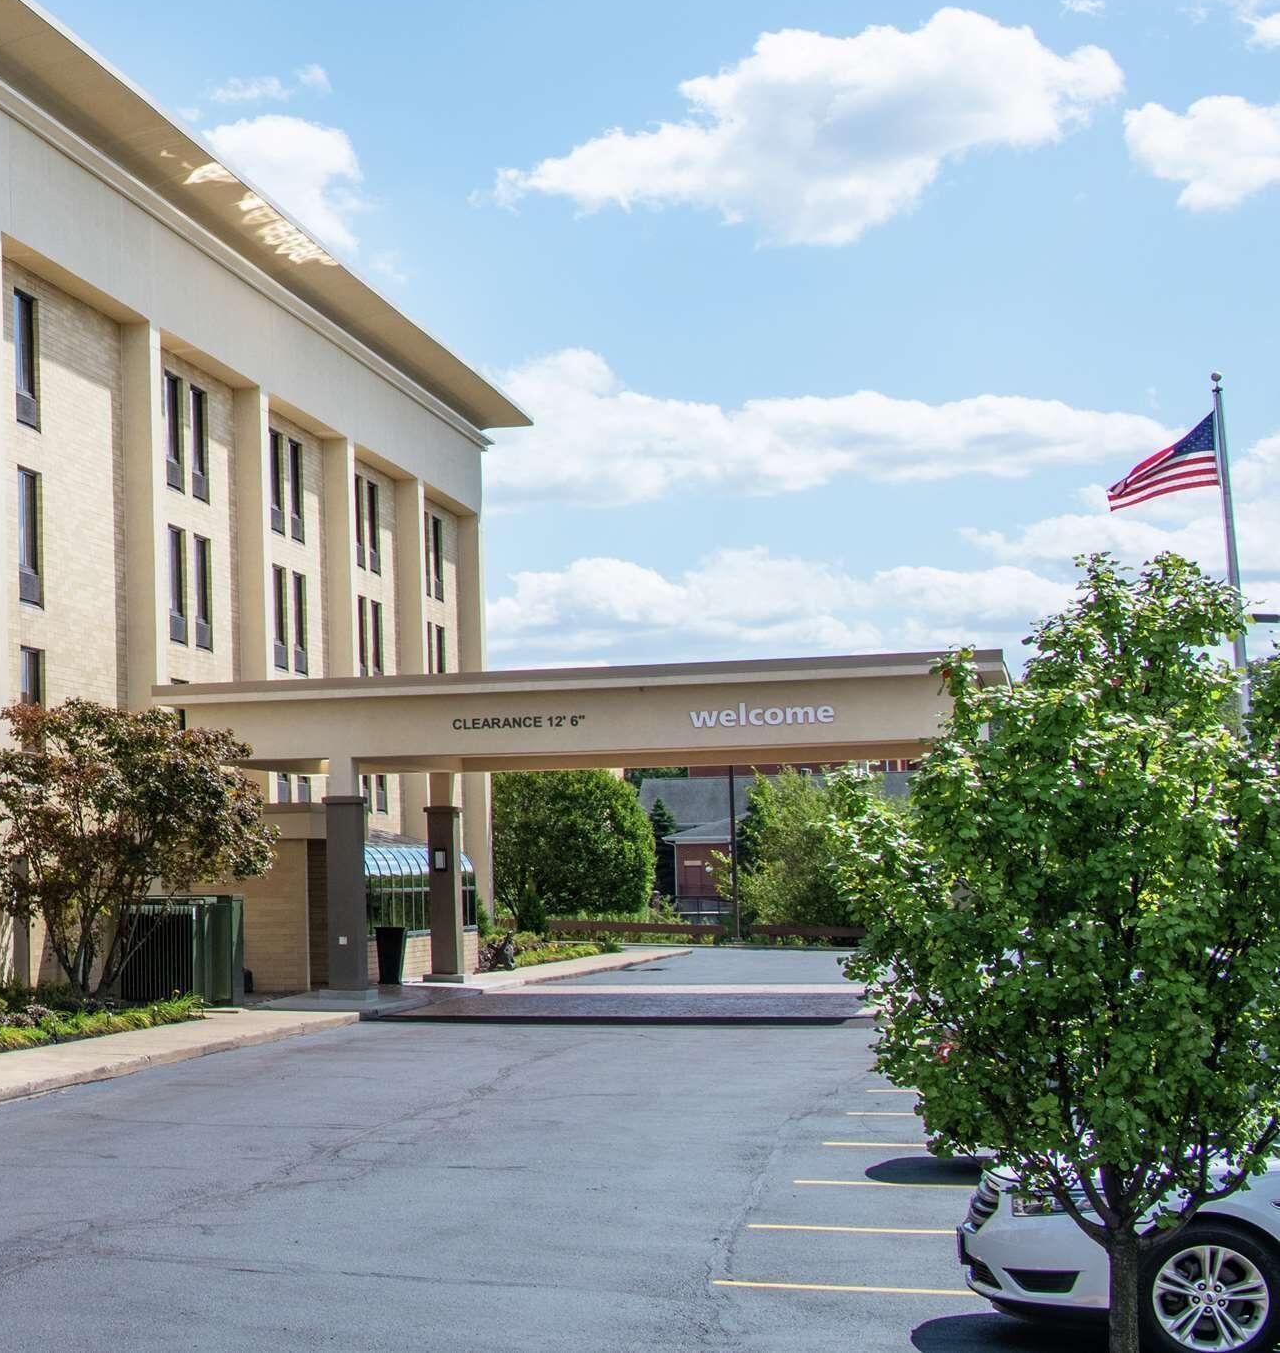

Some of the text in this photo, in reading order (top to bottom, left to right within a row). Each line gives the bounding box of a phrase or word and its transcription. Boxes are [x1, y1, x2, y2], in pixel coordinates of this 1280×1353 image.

[452, 714, 586, 730] CLEARANCE 12' 6"
[689, 702, 835, 728] welcome
